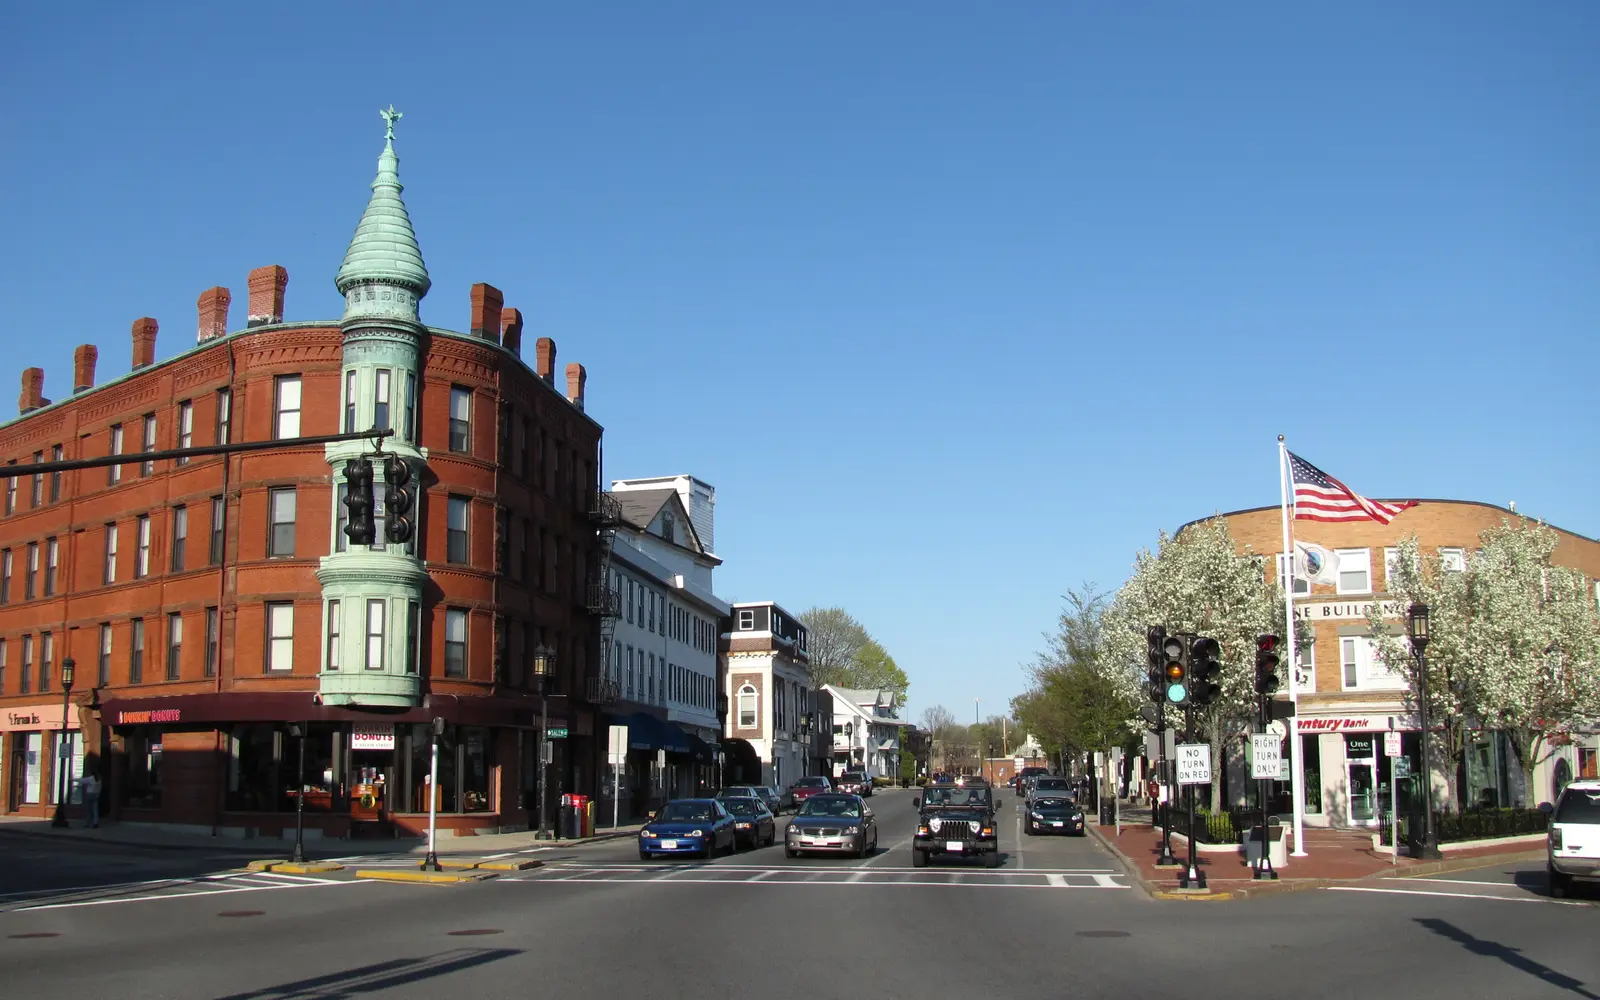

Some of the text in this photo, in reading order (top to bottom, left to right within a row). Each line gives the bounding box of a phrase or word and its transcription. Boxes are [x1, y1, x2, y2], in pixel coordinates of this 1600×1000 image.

[1323, 603, 1405, 617] BUILDNG
[151, 709, 181, 722] DONUTS
[1297, 719, 1369, 732] entury Bank
[354, 733, 393, 741] DONUTS
[1254, 739, 1278, 748] RIGHT
[1349, 740, 1369, 748] One
[1186, 749, 1200, 757] NO
[1256, 751, 1278, 760] TURN
[1182, 760, 1205, 768] TURN
[1256, 764, 1277, 773] ONLY
[1179, 770, 1209, 779] ON RED
